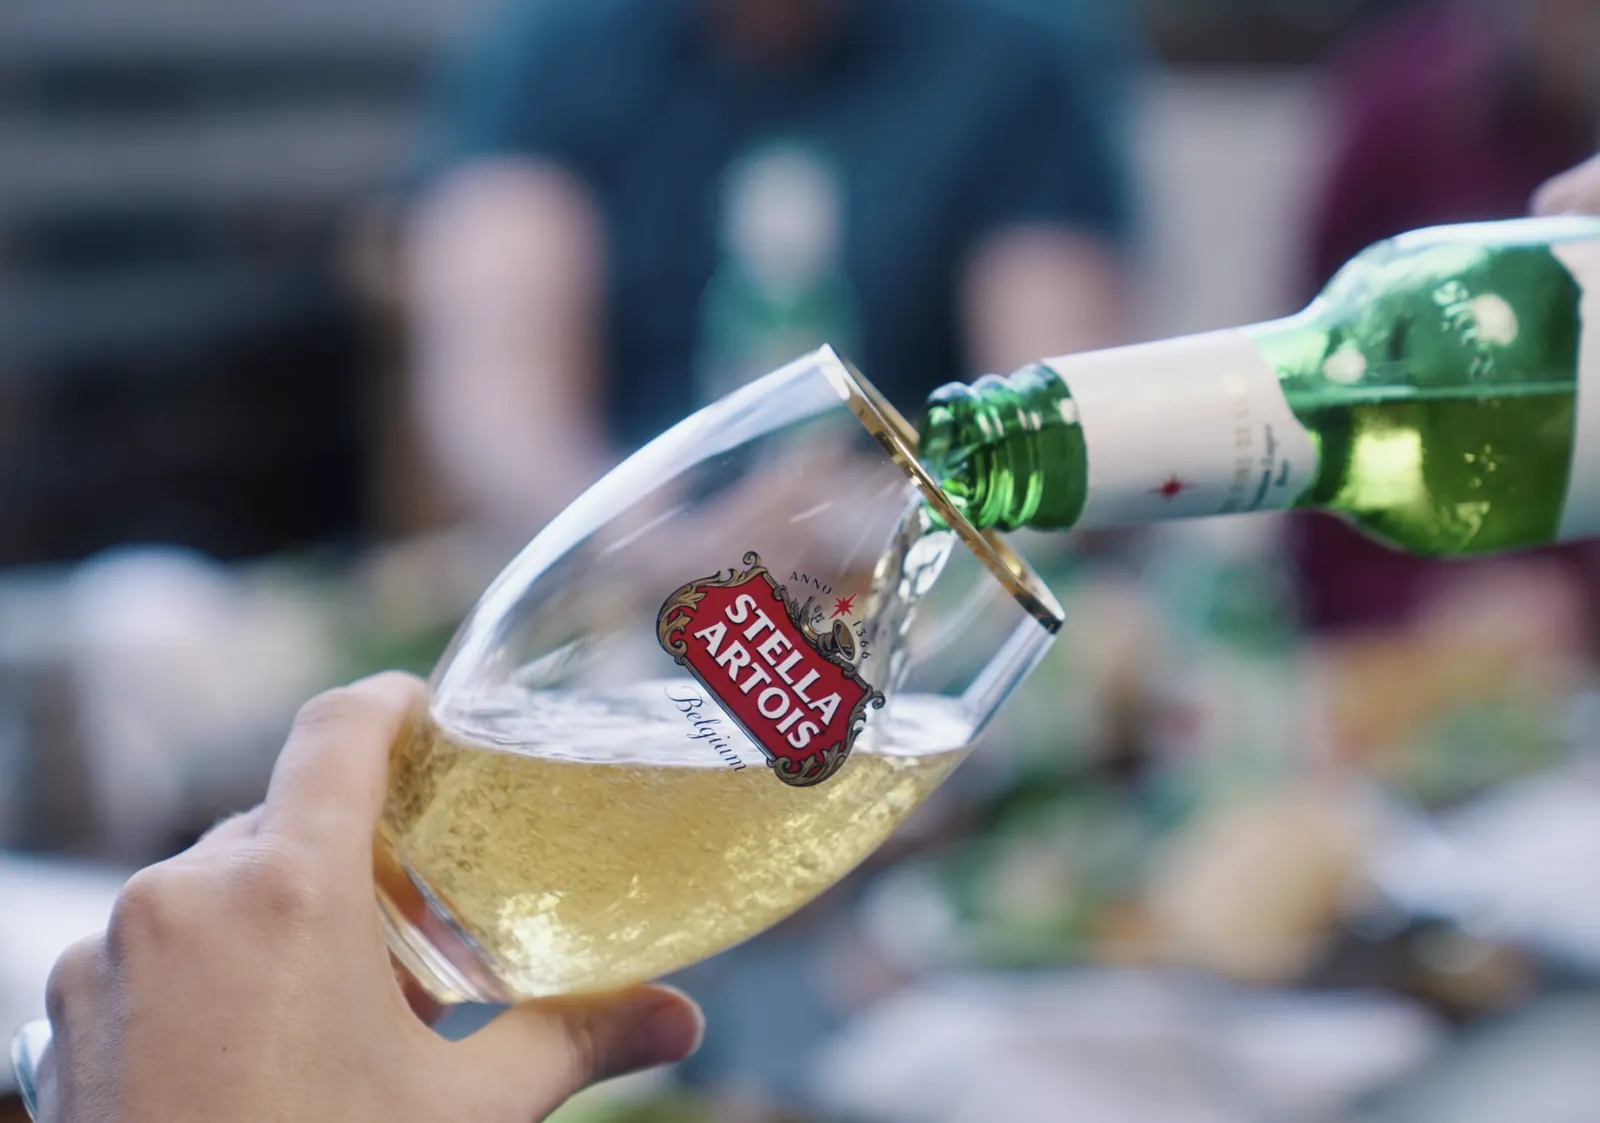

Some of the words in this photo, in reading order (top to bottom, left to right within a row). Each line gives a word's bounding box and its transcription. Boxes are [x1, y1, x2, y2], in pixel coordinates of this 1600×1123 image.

[789, 571, 832, 595] ANNO
[724, 593, 842, 726] STELLA
[852, 620, 871, 660] 1366
[664, 685, 747, 773] Belgium
[693, 621, 820, 749] ARTOIS
